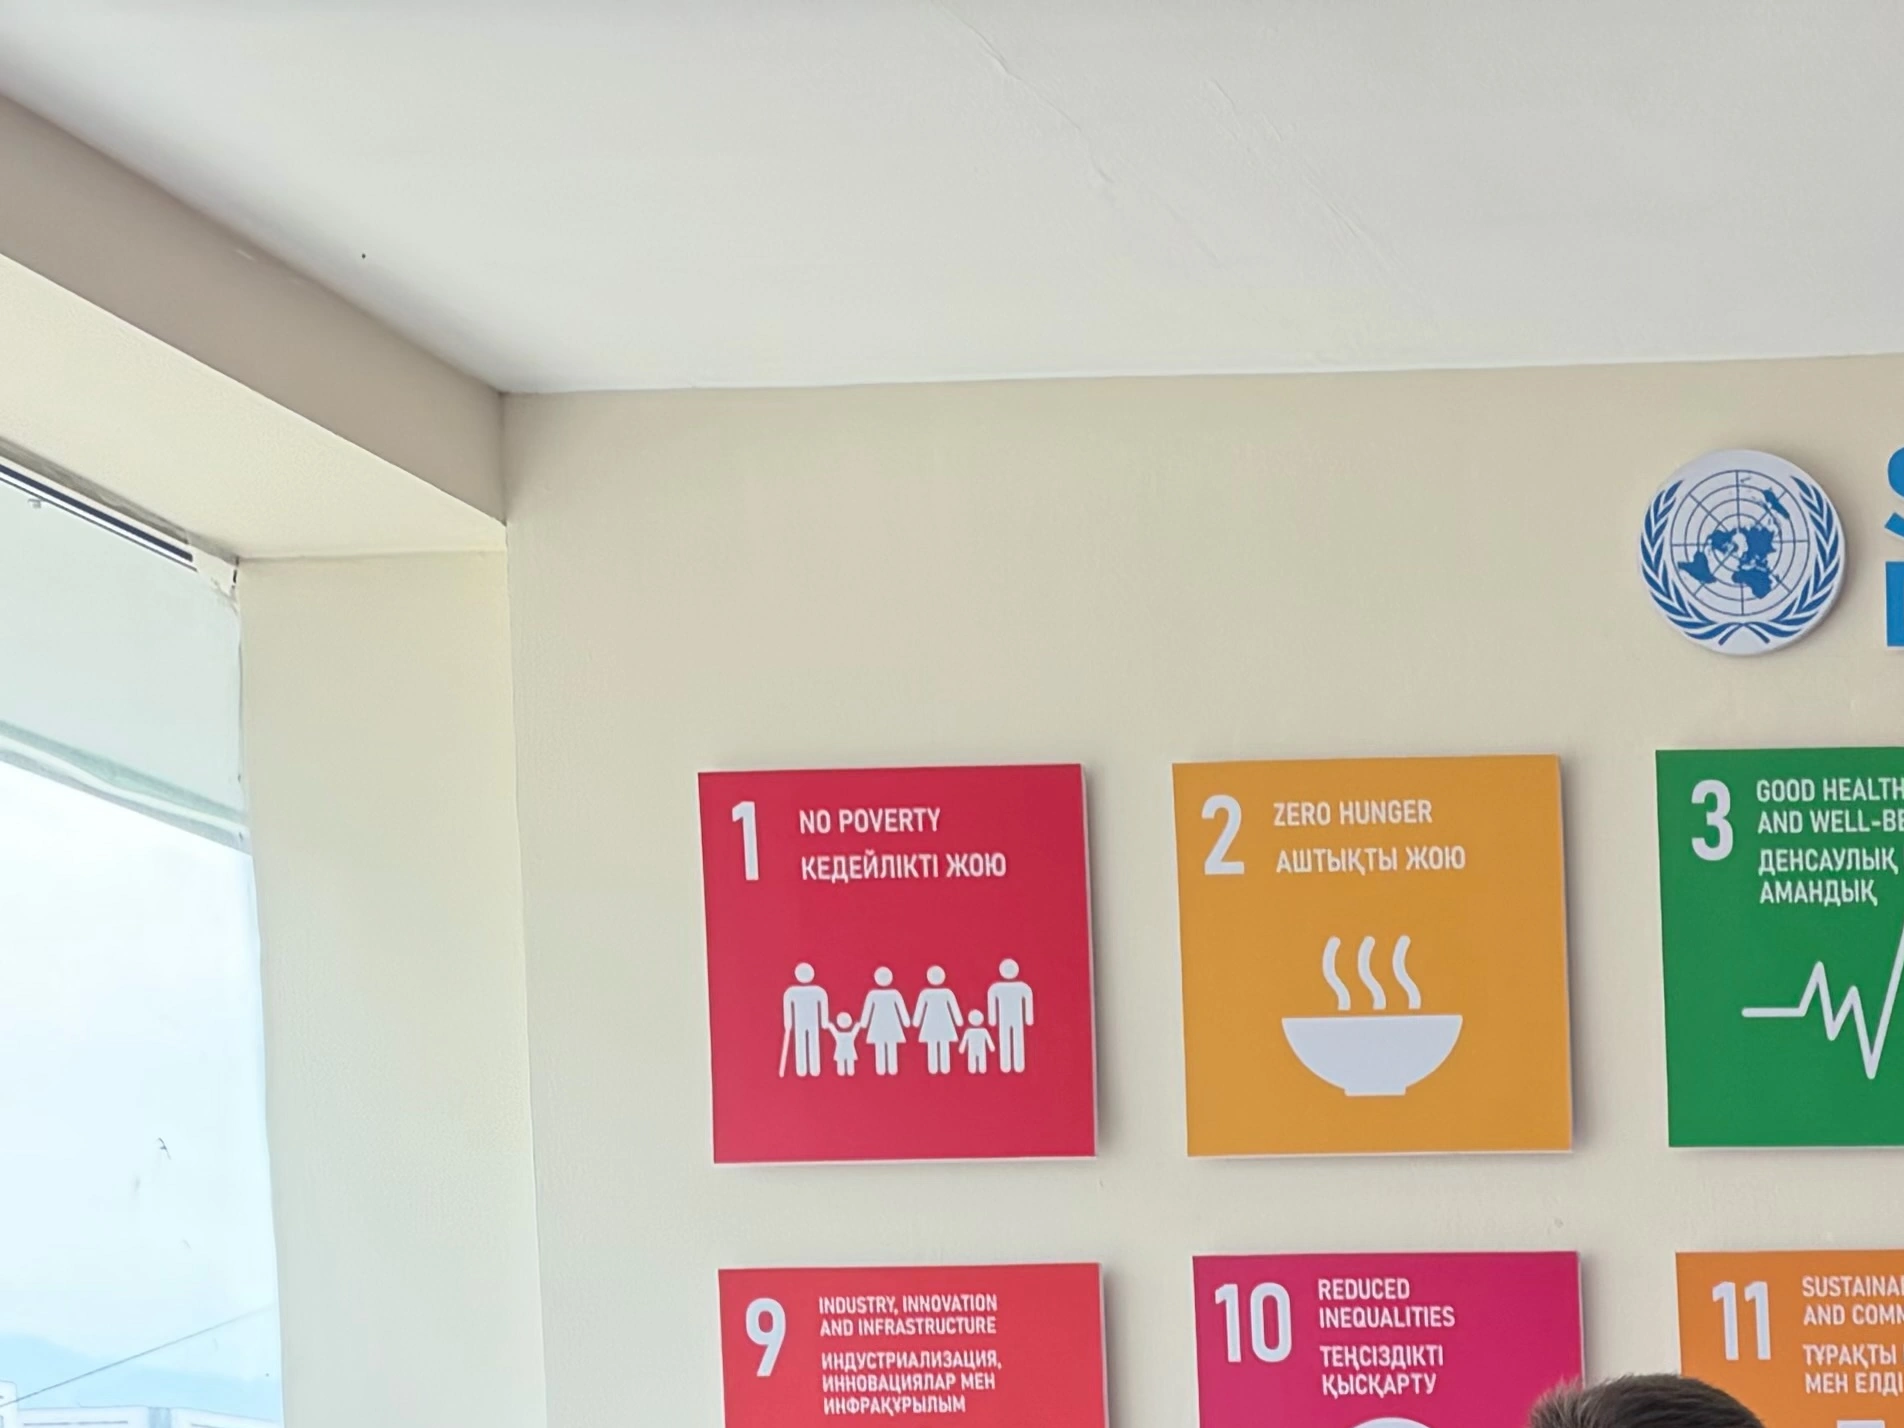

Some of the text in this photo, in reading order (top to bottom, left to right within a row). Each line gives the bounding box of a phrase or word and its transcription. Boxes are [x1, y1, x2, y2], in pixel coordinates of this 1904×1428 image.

[1757, 779, 1815, 802] GOOD
[800, 808, 940, 833] NO POVERTY
[1274, 800, 1432, 826] ZERO HUNGER
[1692, 780, 1733, 860] 3
[1758, 811, 1802, 833] AND
[732, 801, 758, 880] 1
[1202, 795, 1244, 875] 2
[802, 850, 1006, 883] КЕДЕЙЛІКТІ ЖОЮ
[1277, 846, 1465, 875] АШТЫҚТЫ ЖОЮ
[1319, 1279, 1409, 1300] REDUCED
[819, 1294, 997, 1315] INDUSTRY, INNOVATION
[1320, 1306, 1455, 1328] INEQUALITIES
[1804, 1305, 1845, 1325] AND
[821, 1317, 996, 1336] AND INFRASTRUCTURE
[1215, 1283, 1291, 1362] 10
[1712, 1281, 1770, 1360] 11
[746, 1298, 785, 1376] 9
